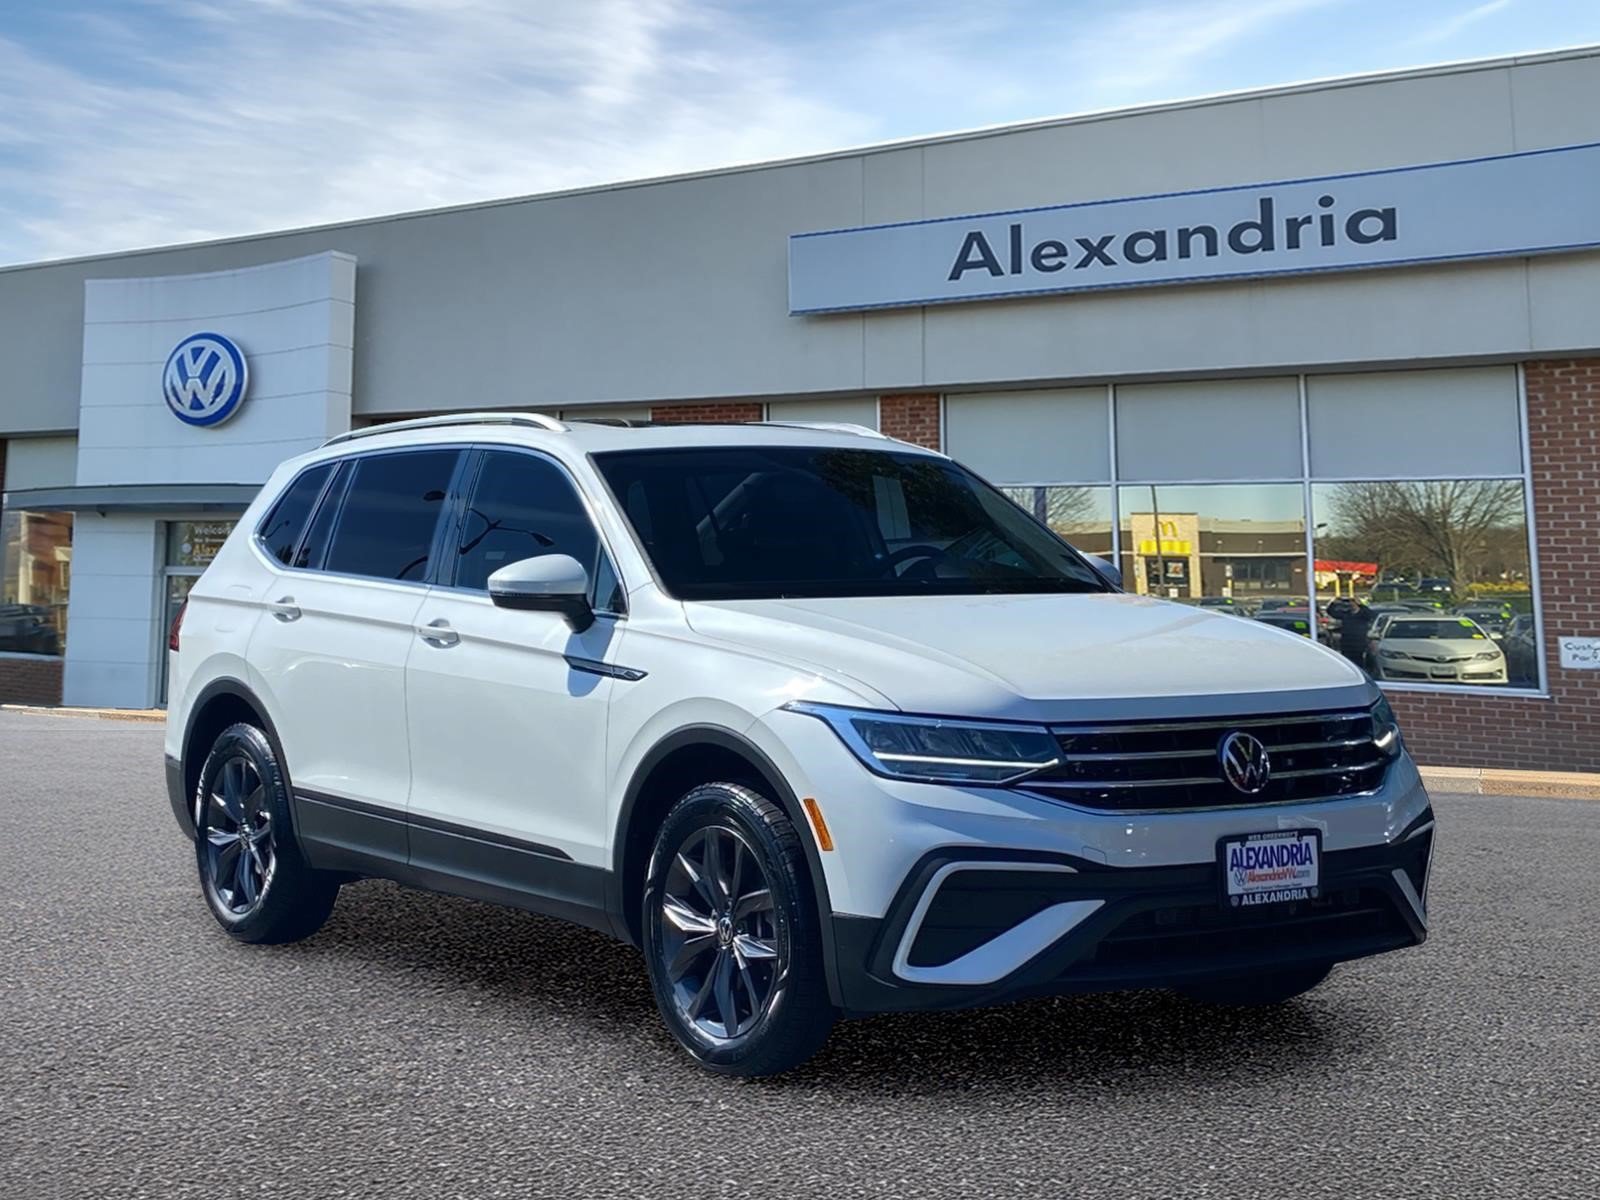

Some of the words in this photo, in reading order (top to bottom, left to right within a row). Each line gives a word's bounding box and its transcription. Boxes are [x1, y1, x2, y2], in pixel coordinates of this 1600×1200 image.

[947, 194, 1398, 281] Alexandria
[1229, 842, 1313, 872] ALEXANDRIA
[1241, 888, 1309, 906] ALEXANDRIA
